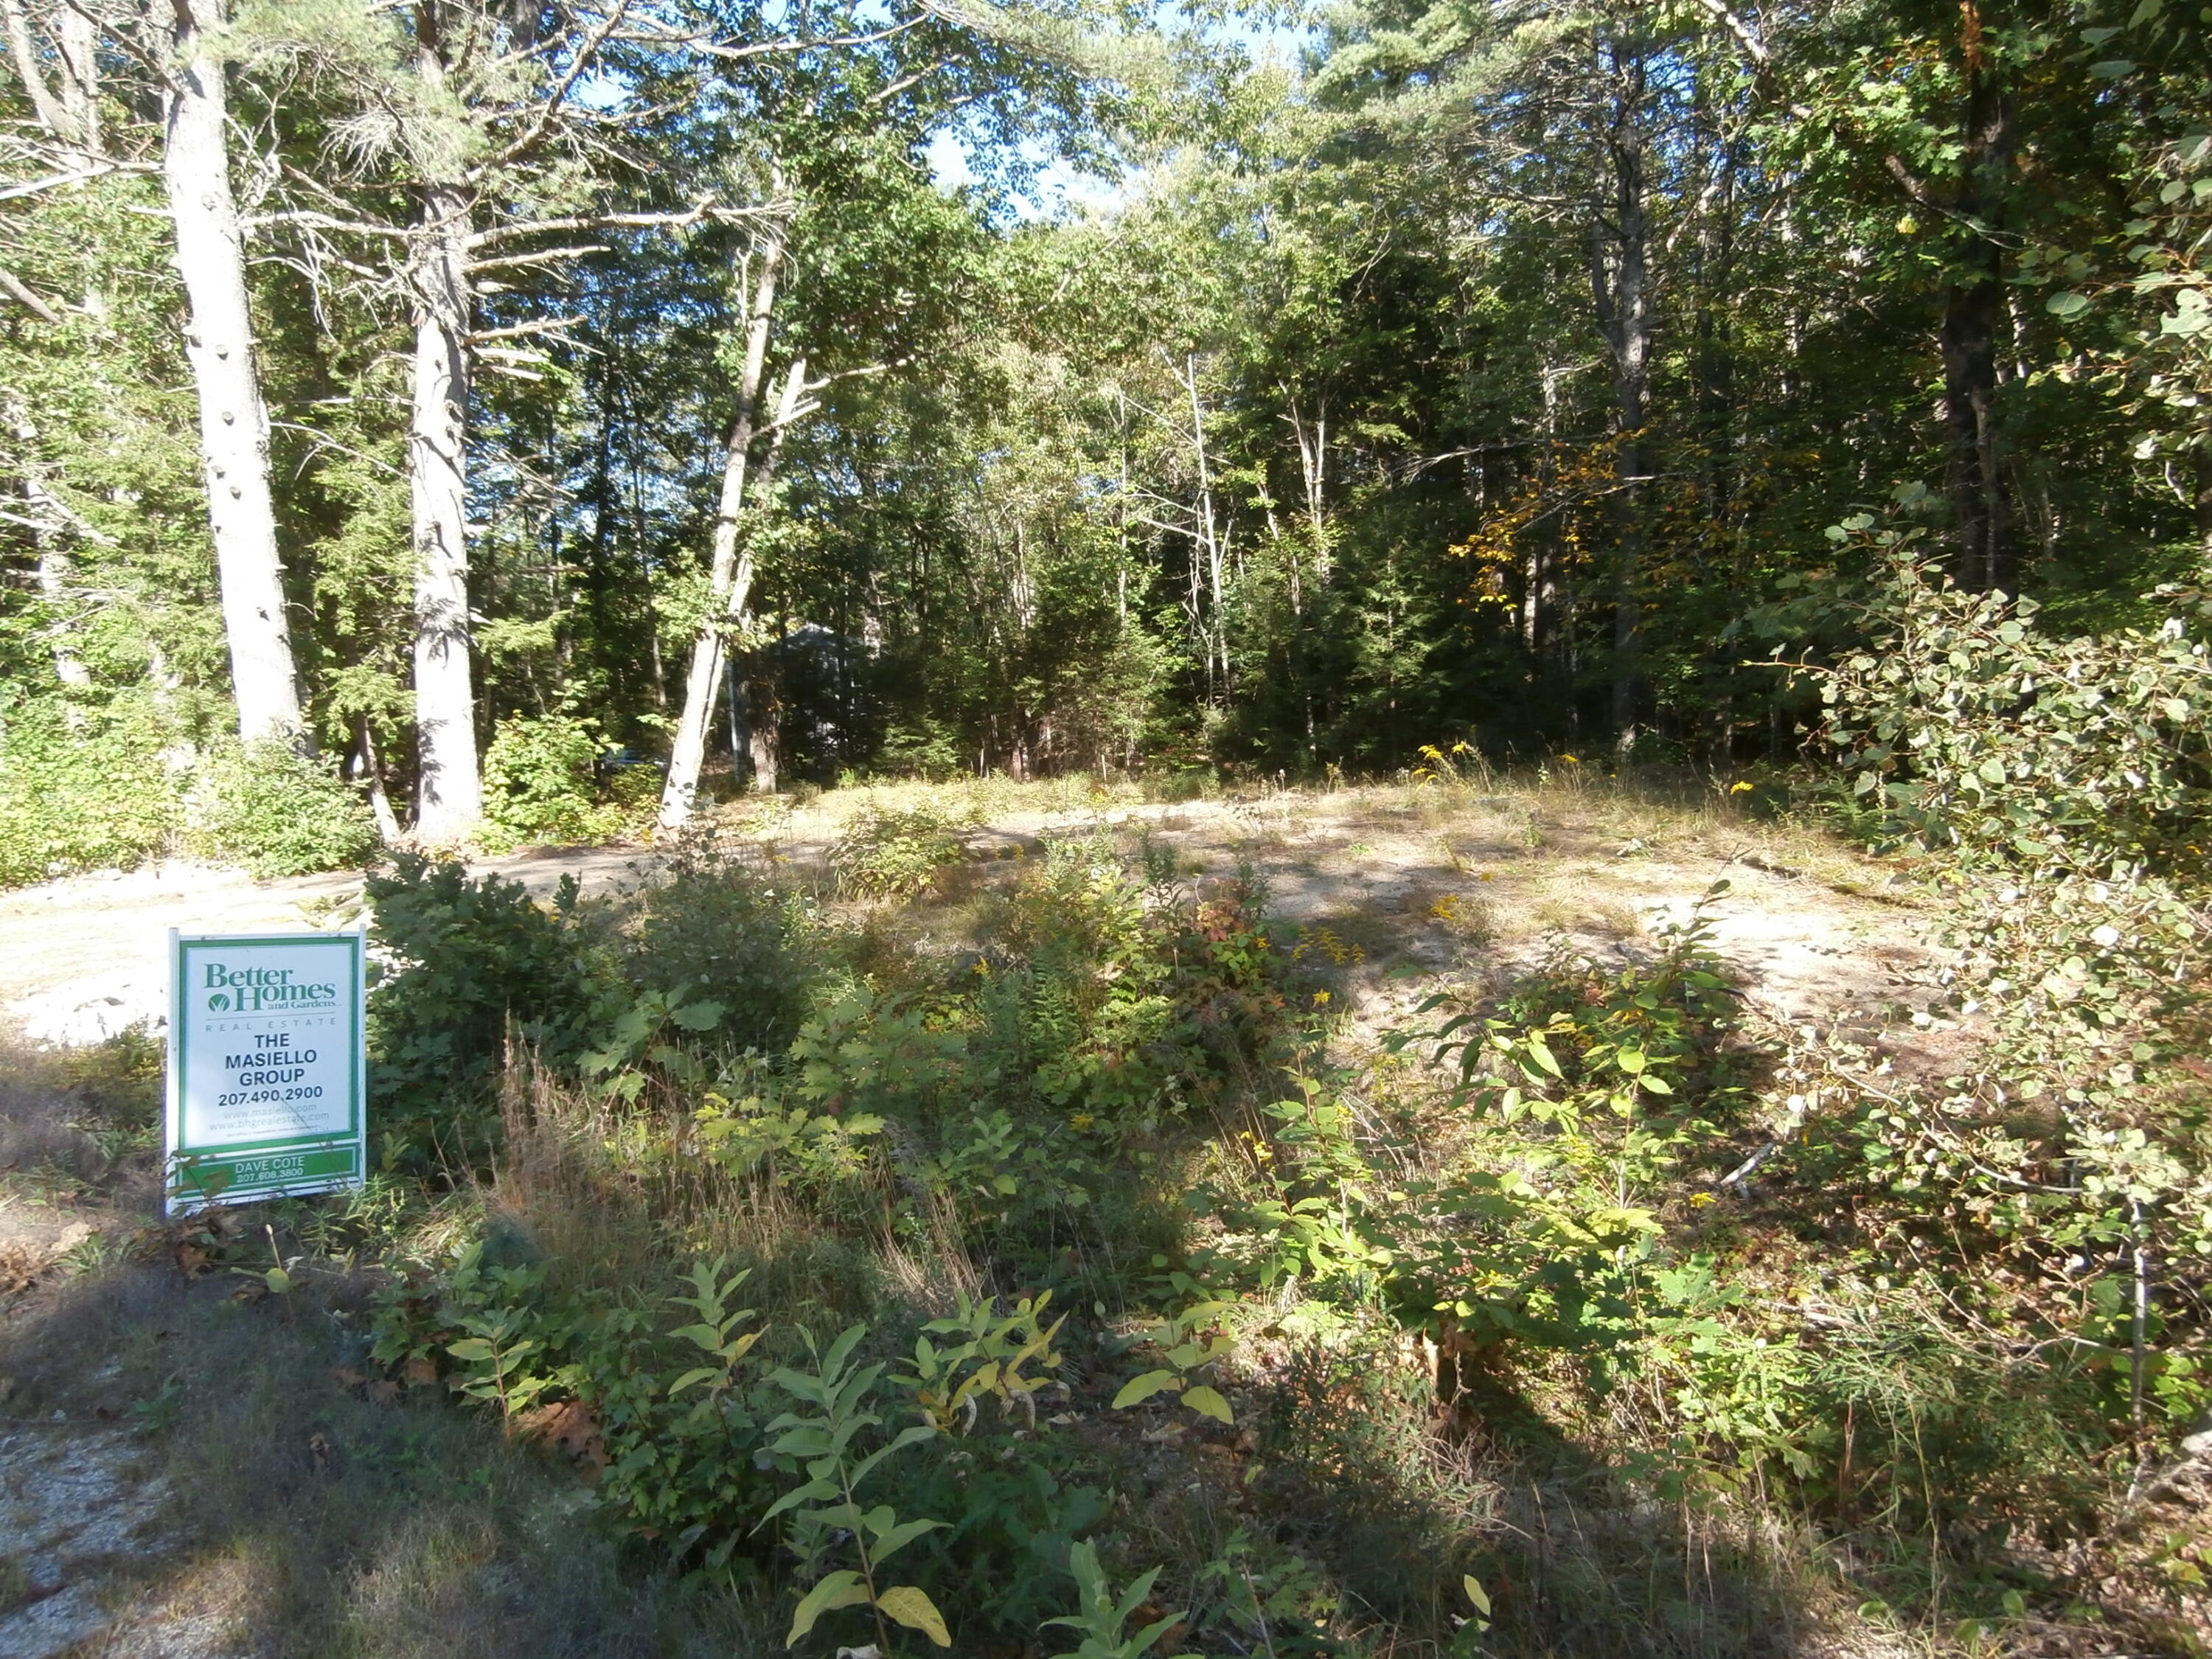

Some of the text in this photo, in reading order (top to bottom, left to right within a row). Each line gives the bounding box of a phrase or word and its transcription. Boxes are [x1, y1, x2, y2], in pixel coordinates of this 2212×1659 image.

[203, 963, 294, 988] Better
[234, 983, 336, 1012] Homes
[268, 1000, 336, 1009] and Gardens
[206, 1018, 336, 1032] REAL ESTATE
[254, 1033, 290, 1048] THE
[226, 1049, 317, 1069] MASIELLO
[240, 1068, 305, 1086] GROUP
[219, 1086, 323, 1106] 207.490.2900
[223, 1103, 316, 1119] www.masiello.com
[210, 1113, 330, 1130] www.bhgrealestate.com
[236, 1156, 305, 1174] DAVE COTE
